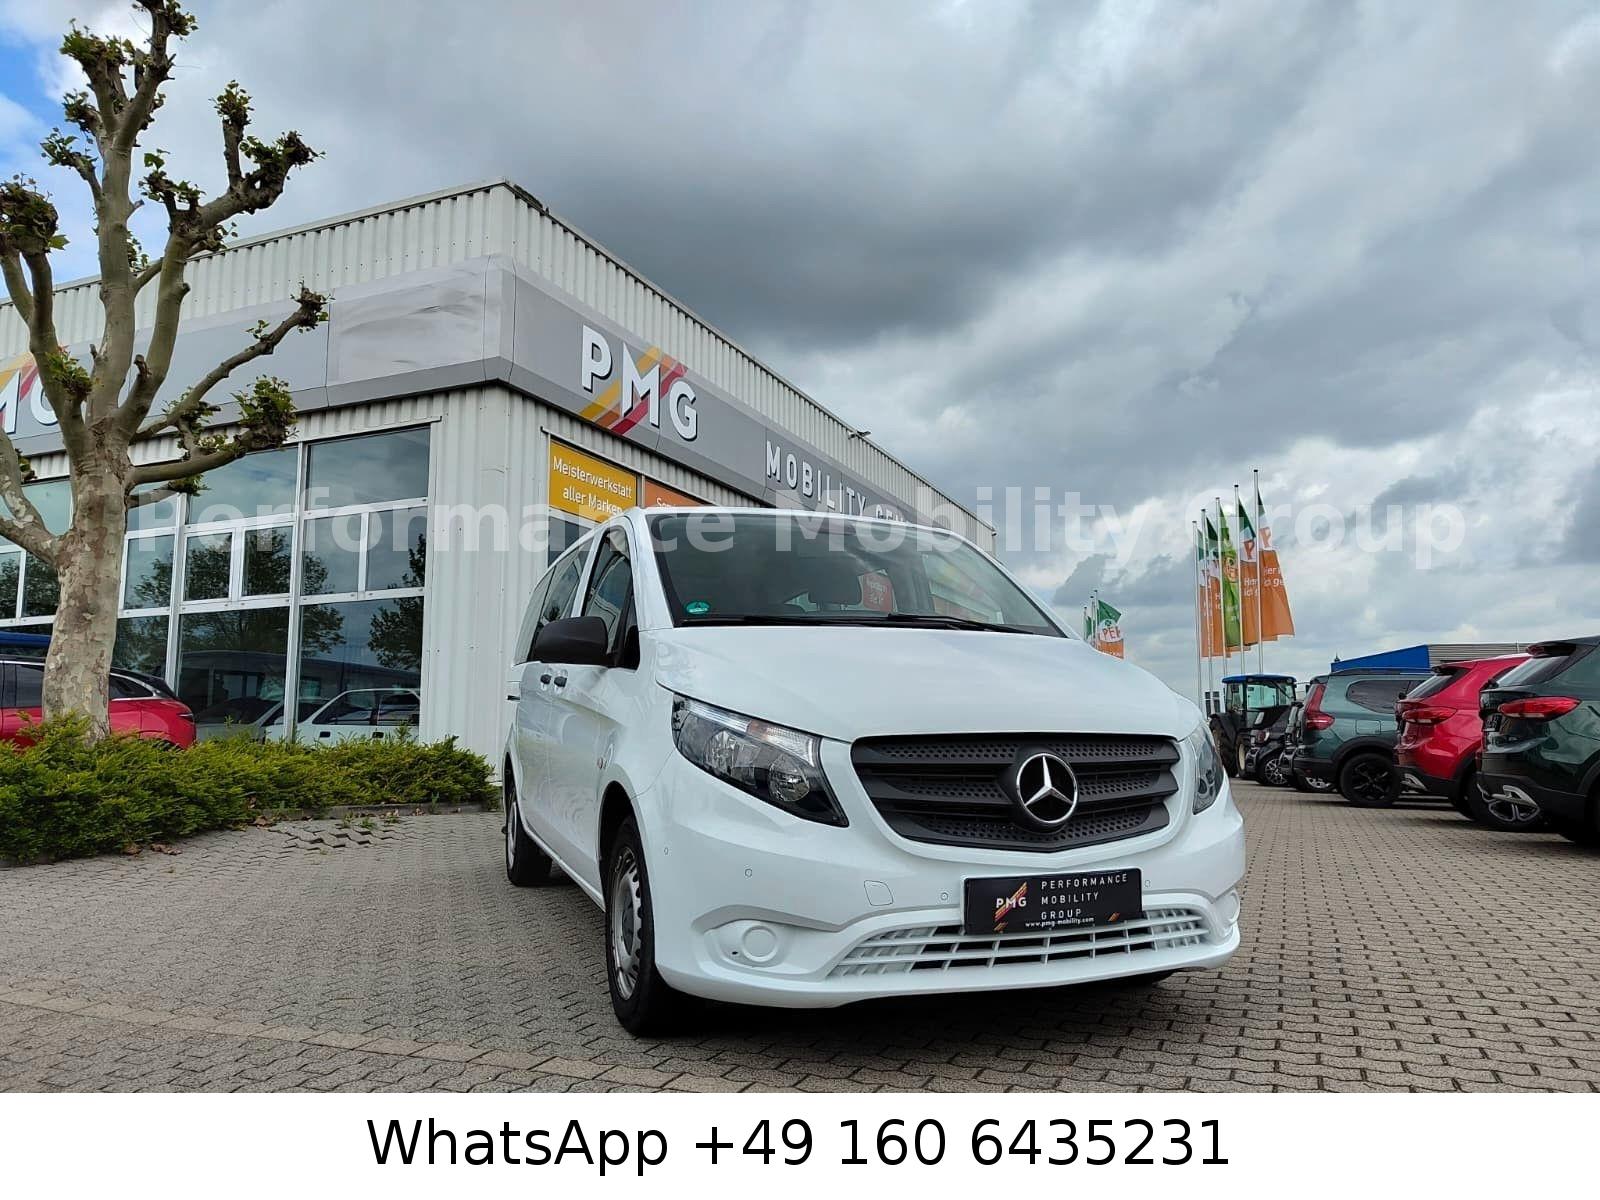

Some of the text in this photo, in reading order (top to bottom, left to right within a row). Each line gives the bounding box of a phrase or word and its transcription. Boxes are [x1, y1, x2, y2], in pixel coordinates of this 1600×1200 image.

[582, 325, 698, 440] PMG
[553, 455, 632, 498] Meisterwerkstatt
[766, 440, 867, 517] MOBILITY
[562, 486, 623, 515] aller Marken
[1041, 873, 1128, 890] PERFORMANCE
[995, 897, 1027, 909] PMG
[1041, 892, 1099, 905] MOBILITY
[1025, 917, 1095, 928] www.pmg-mobility.com
[1041, 908, 1082, 920] GROUP
